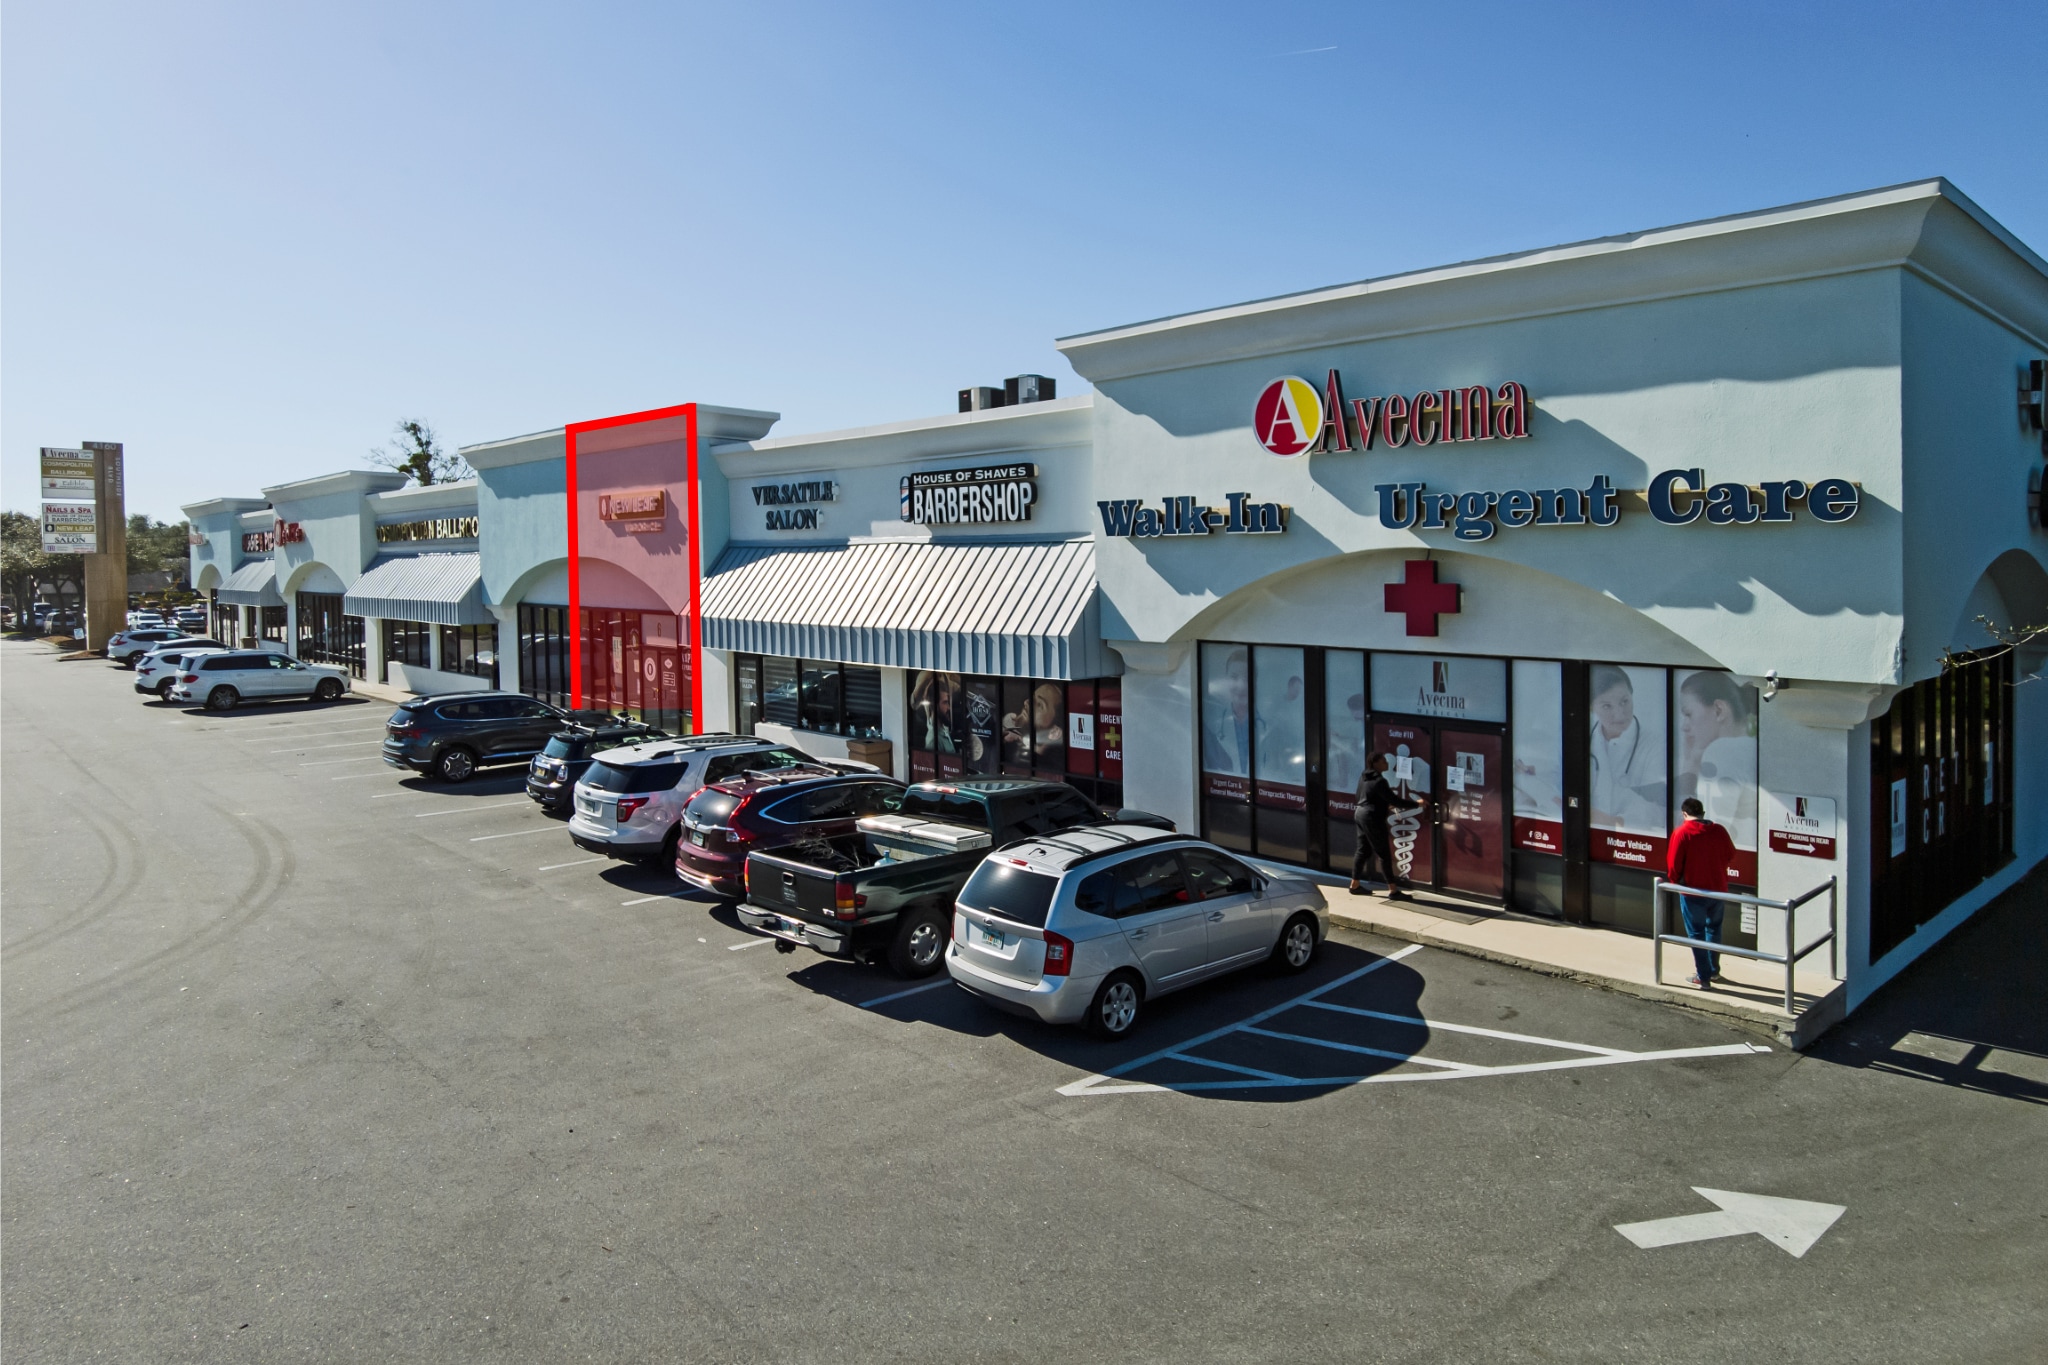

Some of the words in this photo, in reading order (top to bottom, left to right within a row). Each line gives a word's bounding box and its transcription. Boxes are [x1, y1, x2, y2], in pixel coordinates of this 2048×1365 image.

[1314, 368, 1529, 454] Avecina
[913, 472, 952, 485] HOUSE
[955, 471, 972, 481] OF
[975, 466, 1027, 480] SHAVES
[752, 481, 834, 506] VERSATILE
[609, 499, 630, 514] NEW
[632, 496, 658, 512] LEAF
[914, 482, 1034, 525] BARBERSHOP
[1374, 473, 1619, 543] Urgent
[1647, 468, 1860, 526] Care
[766, 508, 819, 531] SALON
[1097, 492, 1286, 538] Walk-In
[436, 516, 480, 539] BALLROO
[1417, 686, 1465, 710] Avecina
[1105, 750, 1121, 760] CARE
[1258, 788, 1286, 799] Chiropractic
[1286, 792, 1306, 803] Therapy
[1329, 800, 1350, 810] Physical
[1785, 812, 1819, 828] Avecina
[1606, 836, 1627, 848] Motor
[1627, 840, 1653, 852] Vehicle
[1773, 831, 1788, 839] MORE
[1788, 834, 1810, 842] PARKING
[1613, 850, 1647, 863] Accidents
